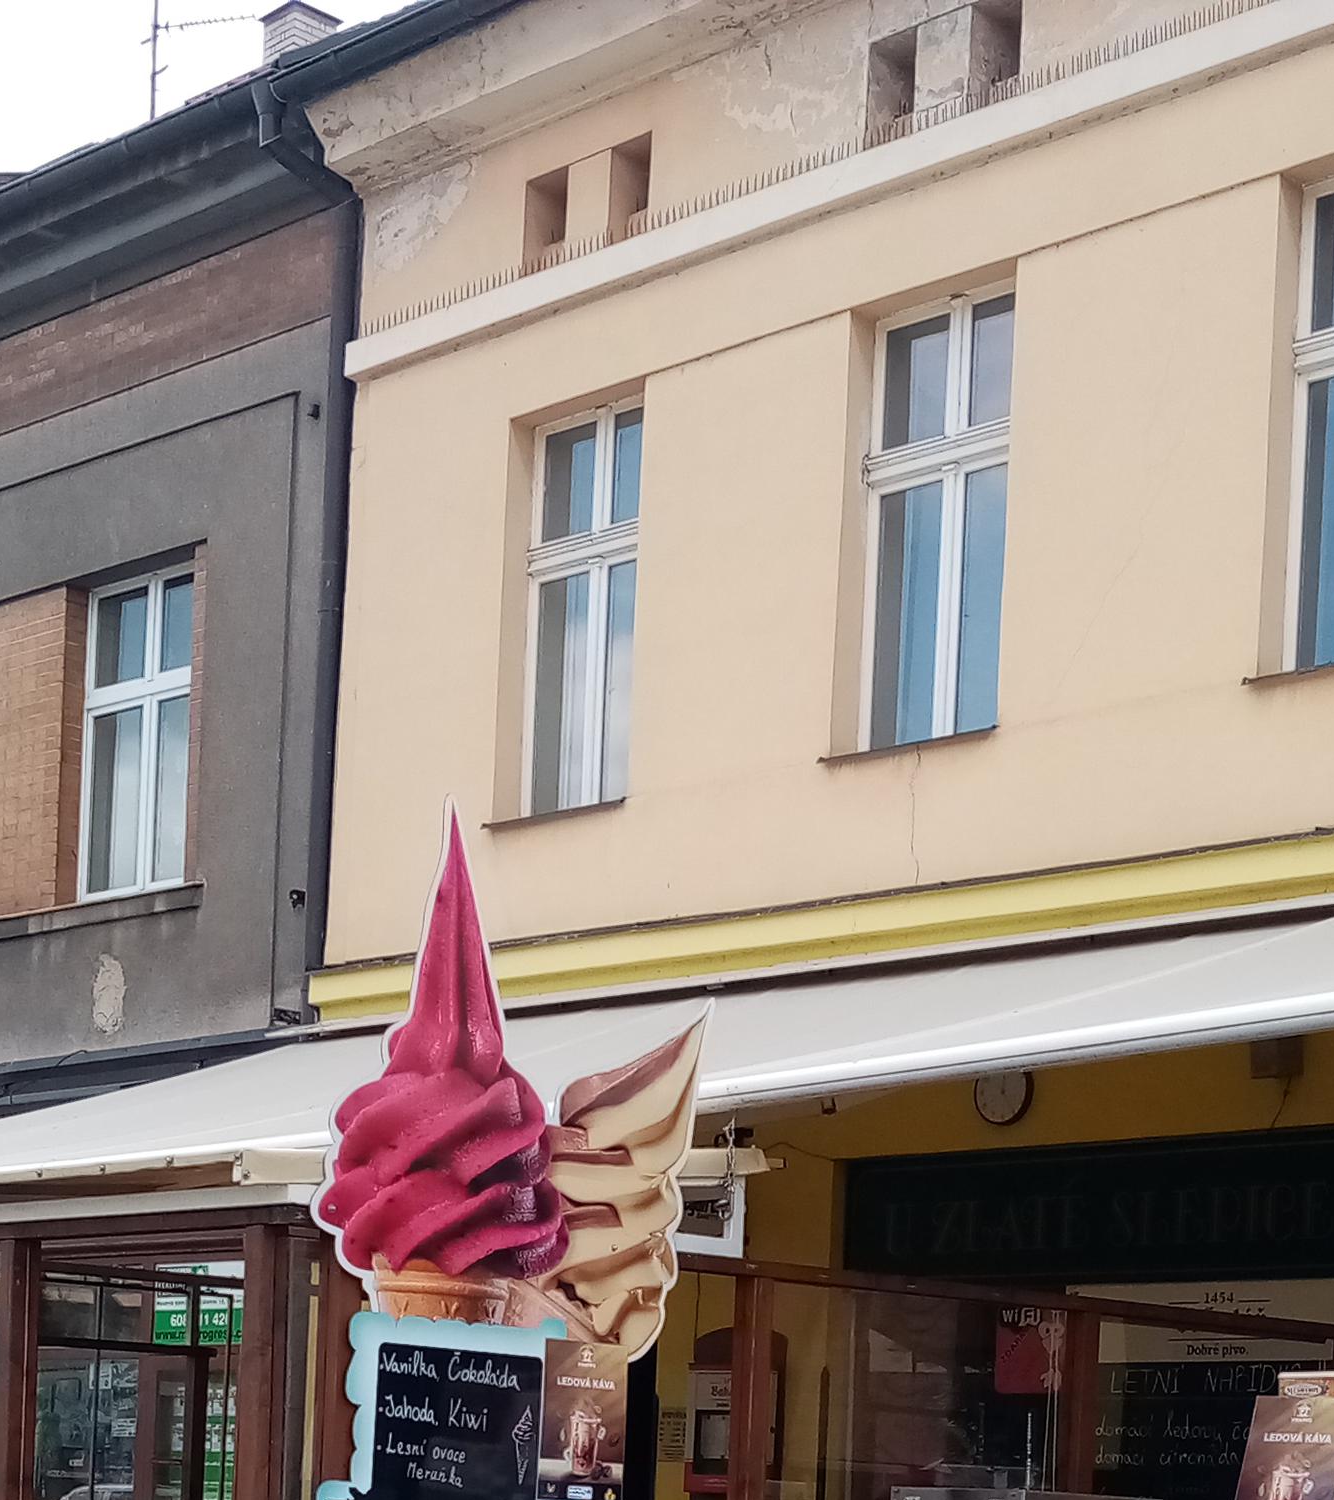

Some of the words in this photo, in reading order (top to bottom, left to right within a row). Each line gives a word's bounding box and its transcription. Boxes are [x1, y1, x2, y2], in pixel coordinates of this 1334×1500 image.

[1203, 1292, 1234, 1304] 1454
[1186, 1342, 1220, 1356] Dobré
[1222, 1343, 1249, 1358] pivo.
[447, 1352, 520, 1391] Čokoláda
[557, 1375, 591, 1389] LEDOVÁ
[592, 1378, 616, 1391] KÁVA
[448, 1398, 488, 1432] Kiwi
[1263, 1431, 1304, 1443] LEDOVÁ
[1305, 1433, 1332, 1445] KÁVA
[386, 1433, 425, 1456] Lesní
[432, 1447, 466, 1463] ovoce
